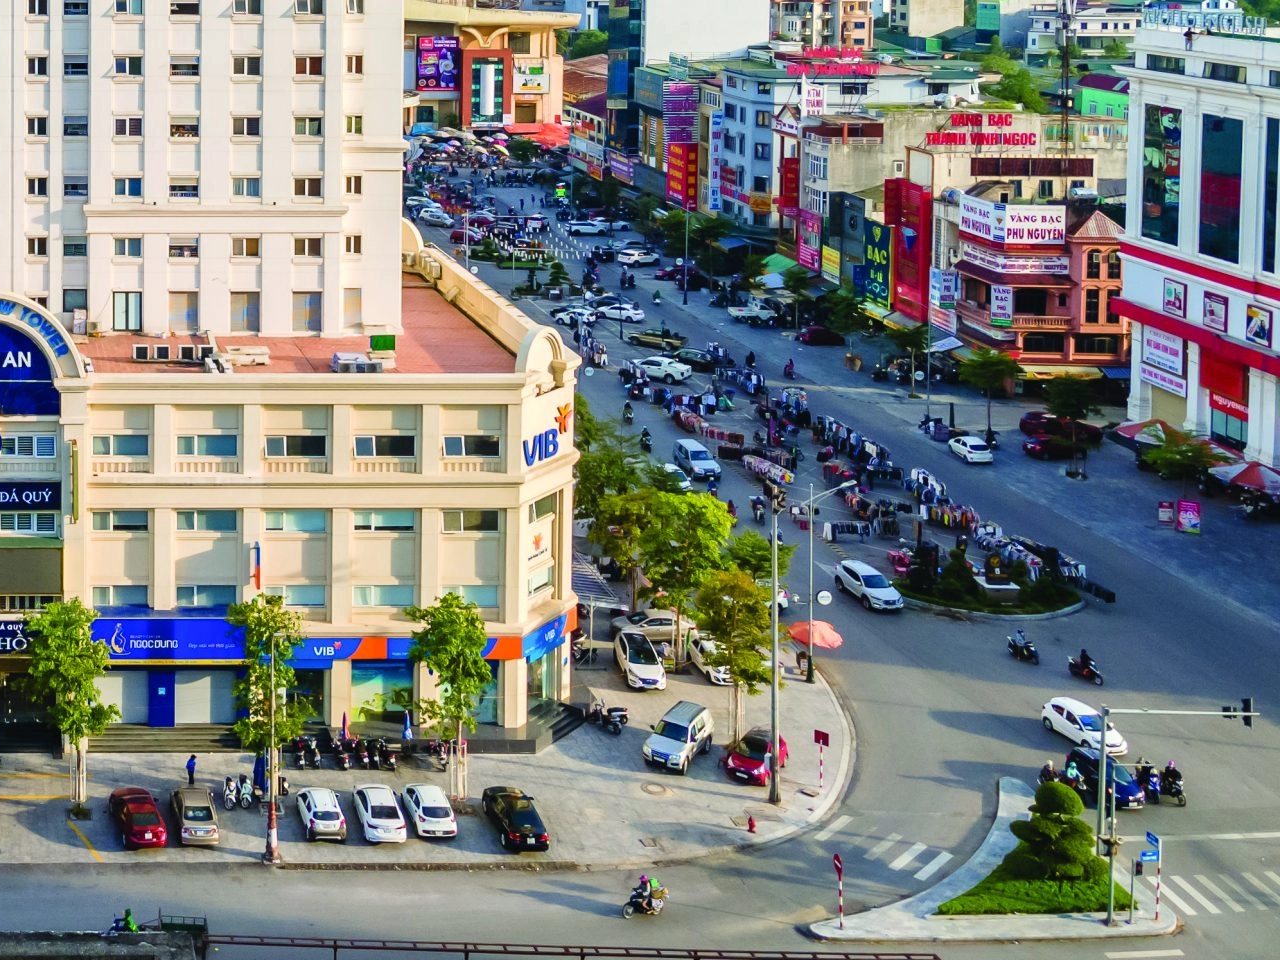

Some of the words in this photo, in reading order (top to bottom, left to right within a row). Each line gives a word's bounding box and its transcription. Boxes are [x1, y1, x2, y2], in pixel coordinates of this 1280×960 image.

[1010, 212, 1037, 223] VÀNG
[19, 307, 69, 358] TOWER
[2, 351, 31, 368] AN
[523, 428, 559, 467] VIB
[0, 488, 19, 503] ĐÁ
[22, 488, 52, 504] QUÝ
[7, 622, 24, 631] QUÝ
[313, 646, 335, 656] VIB
